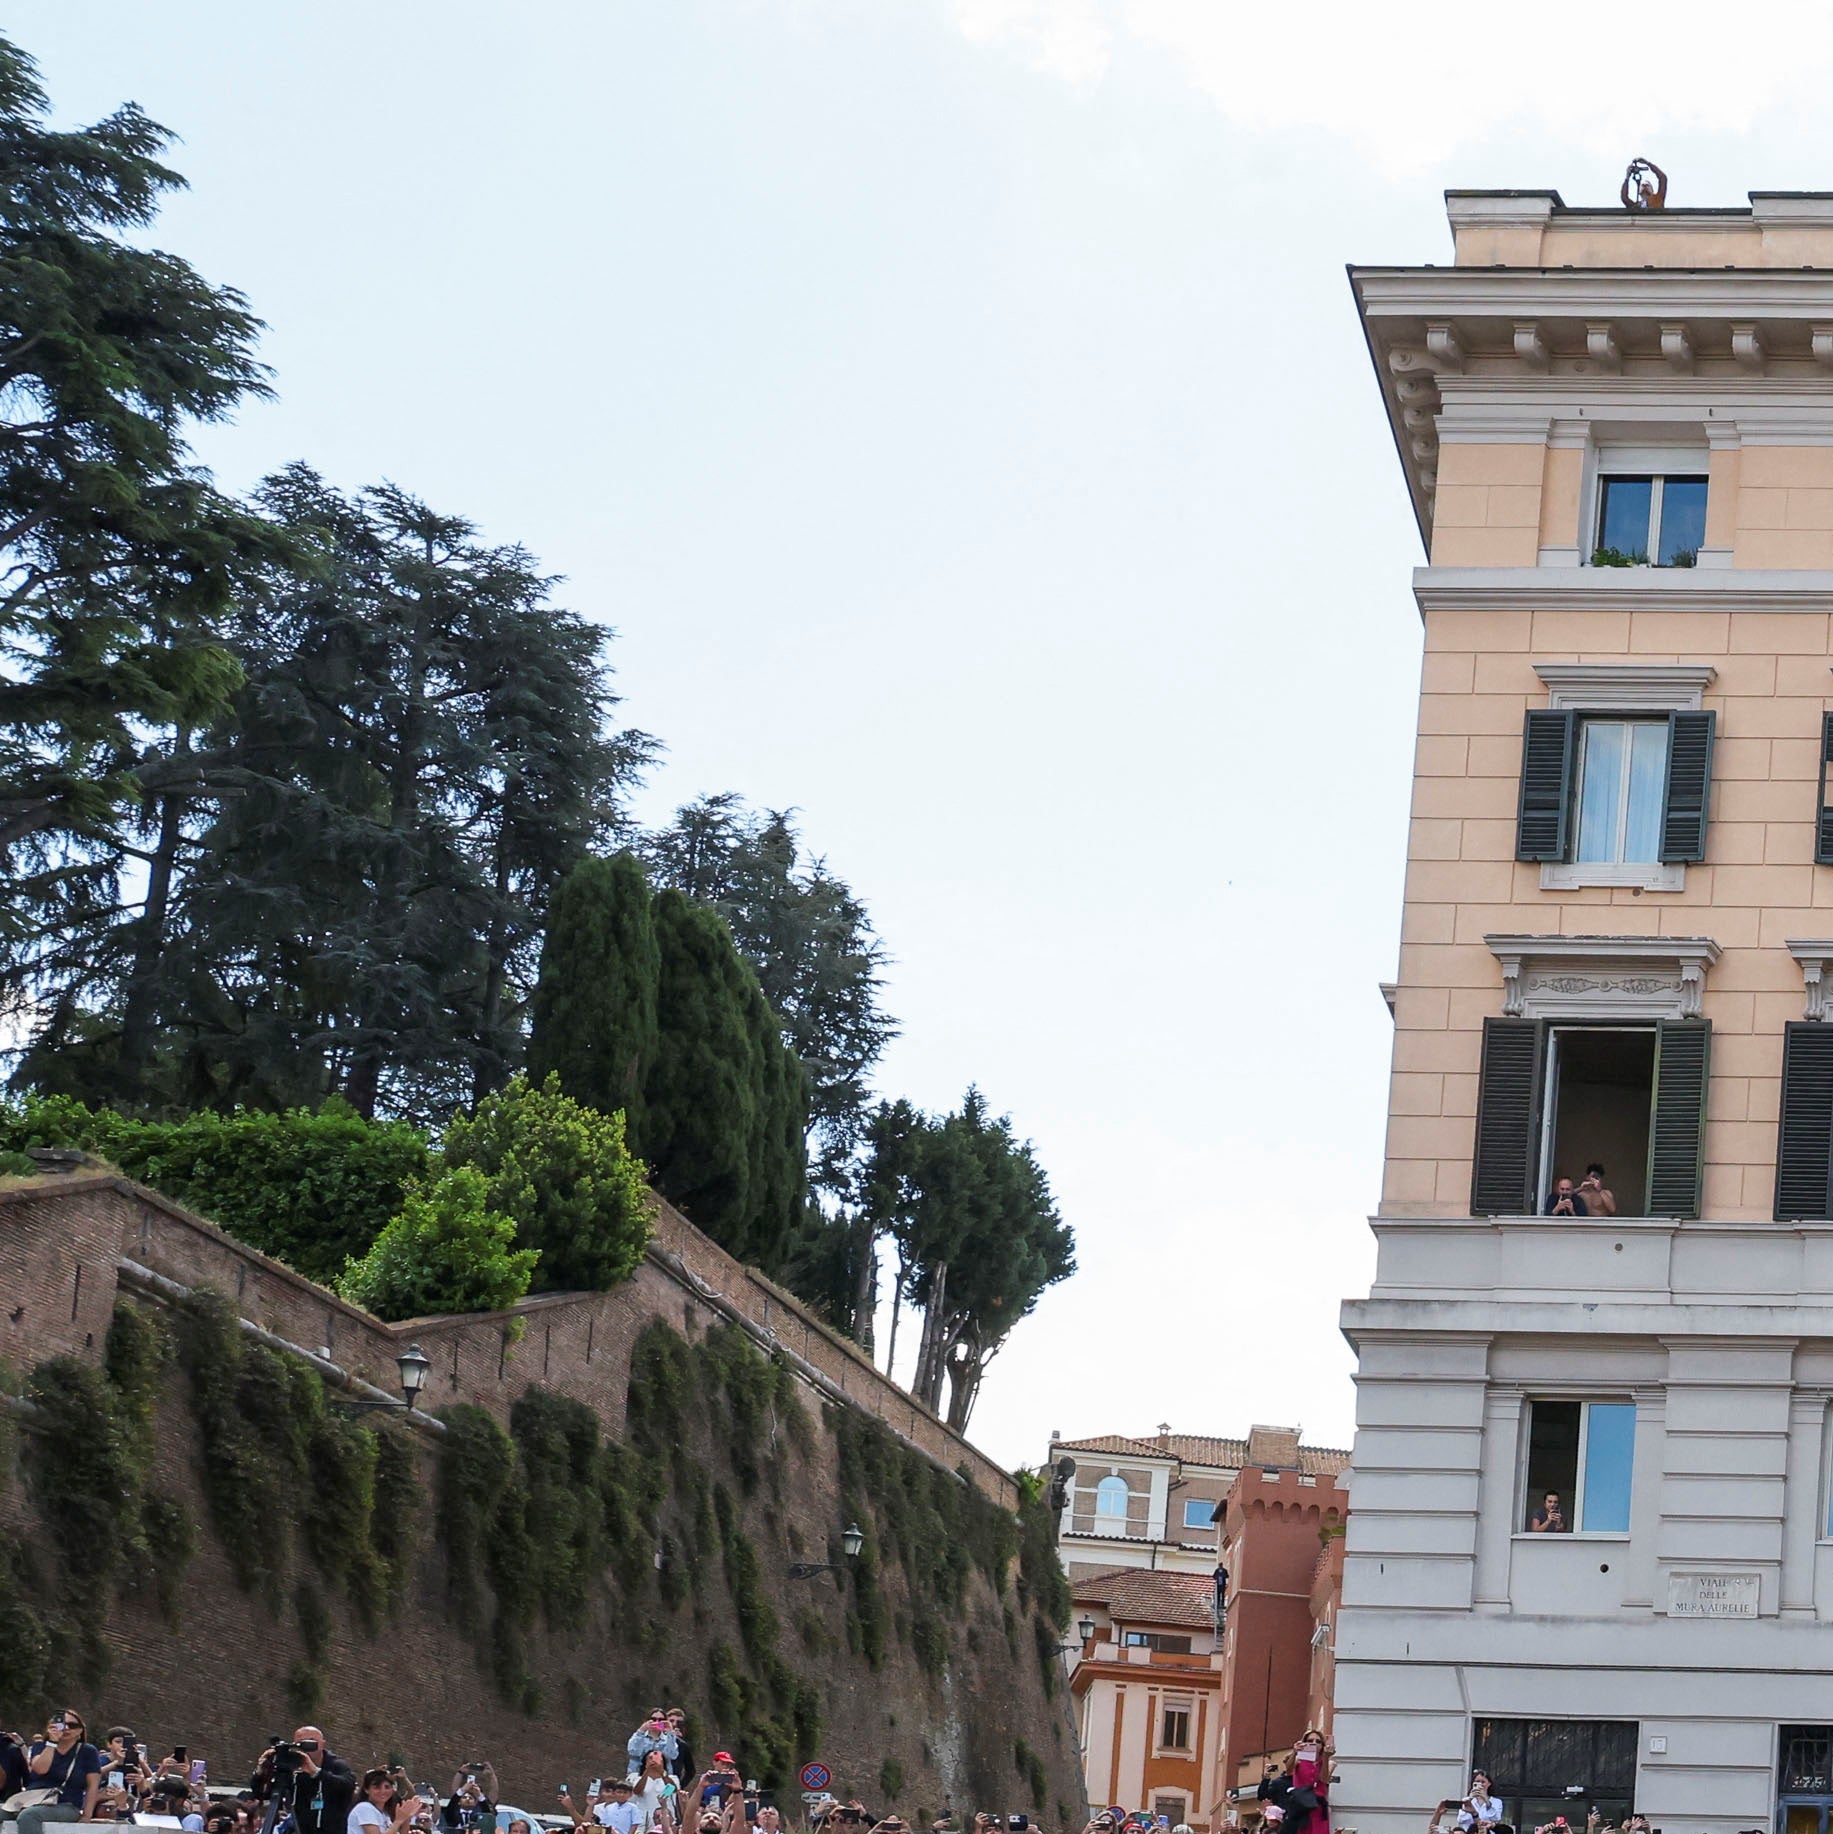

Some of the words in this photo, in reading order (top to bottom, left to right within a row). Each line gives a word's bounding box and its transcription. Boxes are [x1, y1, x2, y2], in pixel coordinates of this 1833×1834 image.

[1699, 1591, 1727, 1600] DELLE
[1675, 1602, 1705, 1613] MURA
[1709, 1603, 1750, 1613] AURELIE
